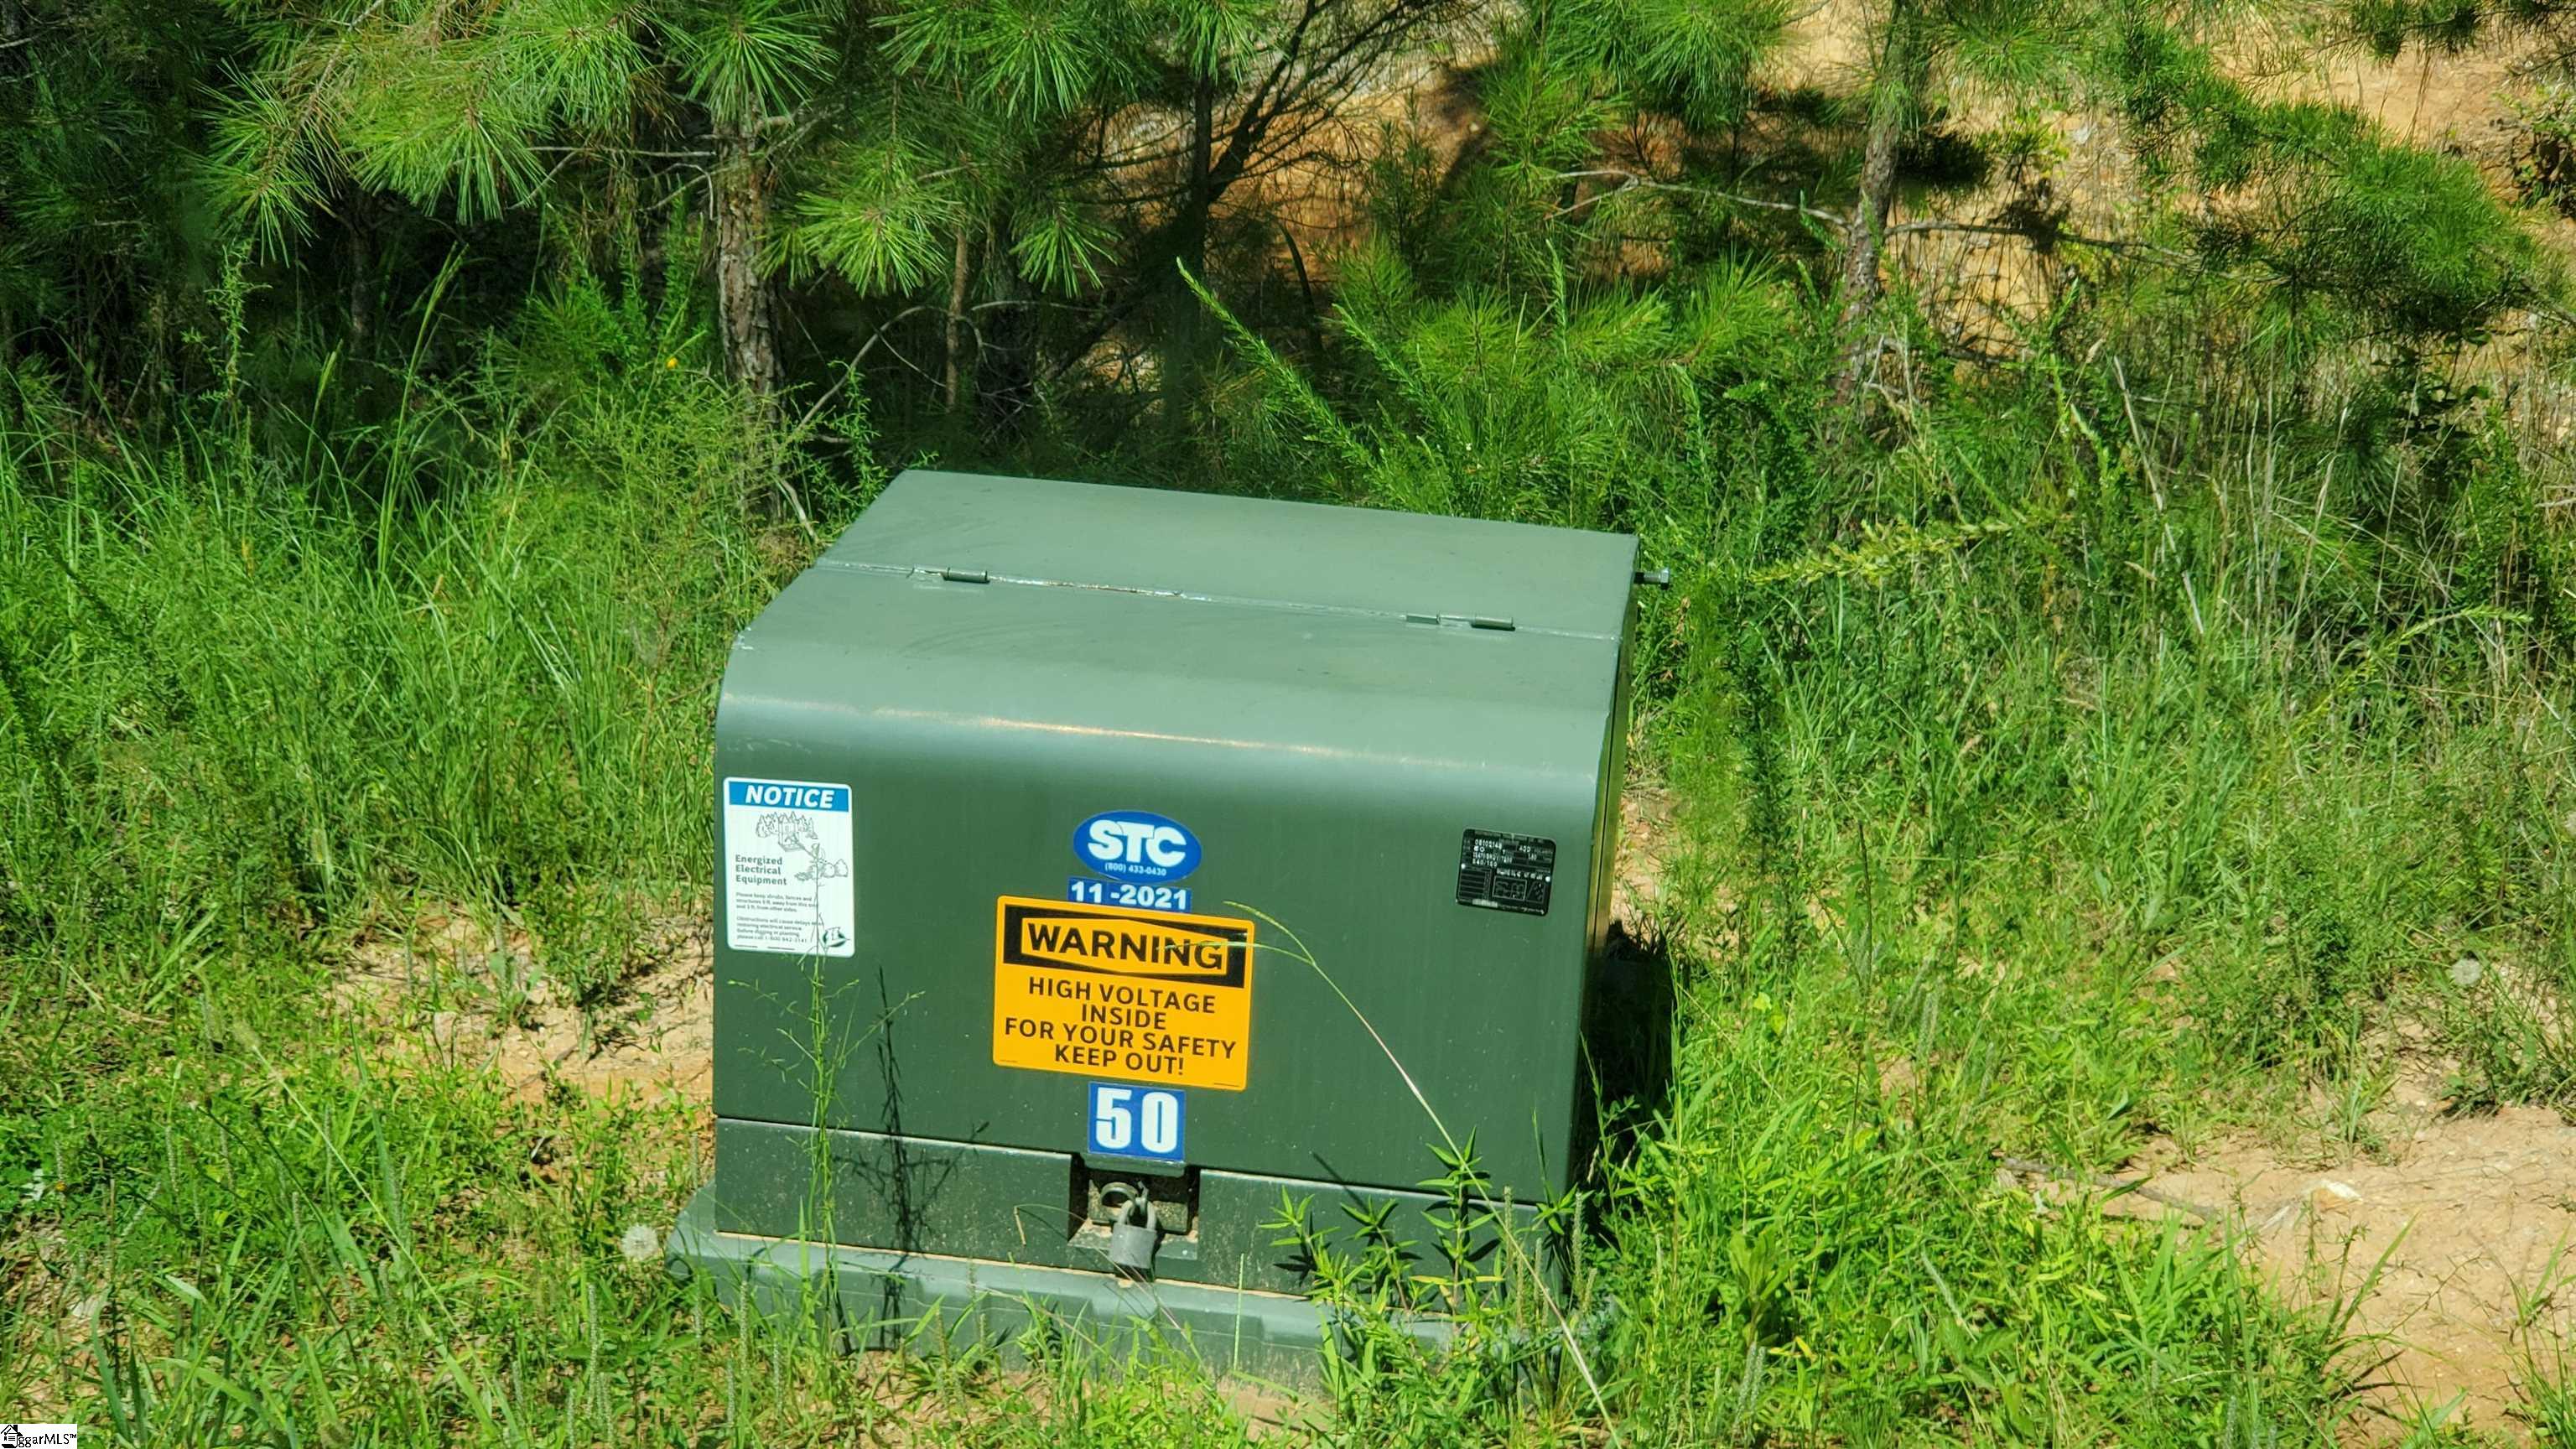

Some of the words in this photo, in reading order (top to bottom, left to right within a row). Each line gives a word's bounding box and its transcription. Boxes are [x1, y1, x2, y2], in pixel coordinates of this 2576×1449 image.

[745, 785, 835, 809] NOTICE
[1088, 819, 1187, 867] STC
[735, 854, 782, 865] Energized
[735, 864, 781, 875] Electrical
[1104, 862, 1126, 873] (800)
[1128, 864, 1166, 876] 433-0430
[735, 875, 787, 886] Equipment
[1027, 922, 1223, 970] WARNING
[1029, 976, 1090, 1000] HIGH
[1098, 984, 1216, 1014] VOLTAGE
[1082, 1004, 1166, 1030] INSIDE
[1005, 1017, 1054, 1040] FOR
[1062, 1022, 1134, 1048] YOUR
[1142, 1032, 1237, 1059] SAFETY
[1055, 1043, 1117, 1067] KEEP
[1125, 1052, 1184, 1076] OUT!
[1096, 1087, 1178, 1153] 50
